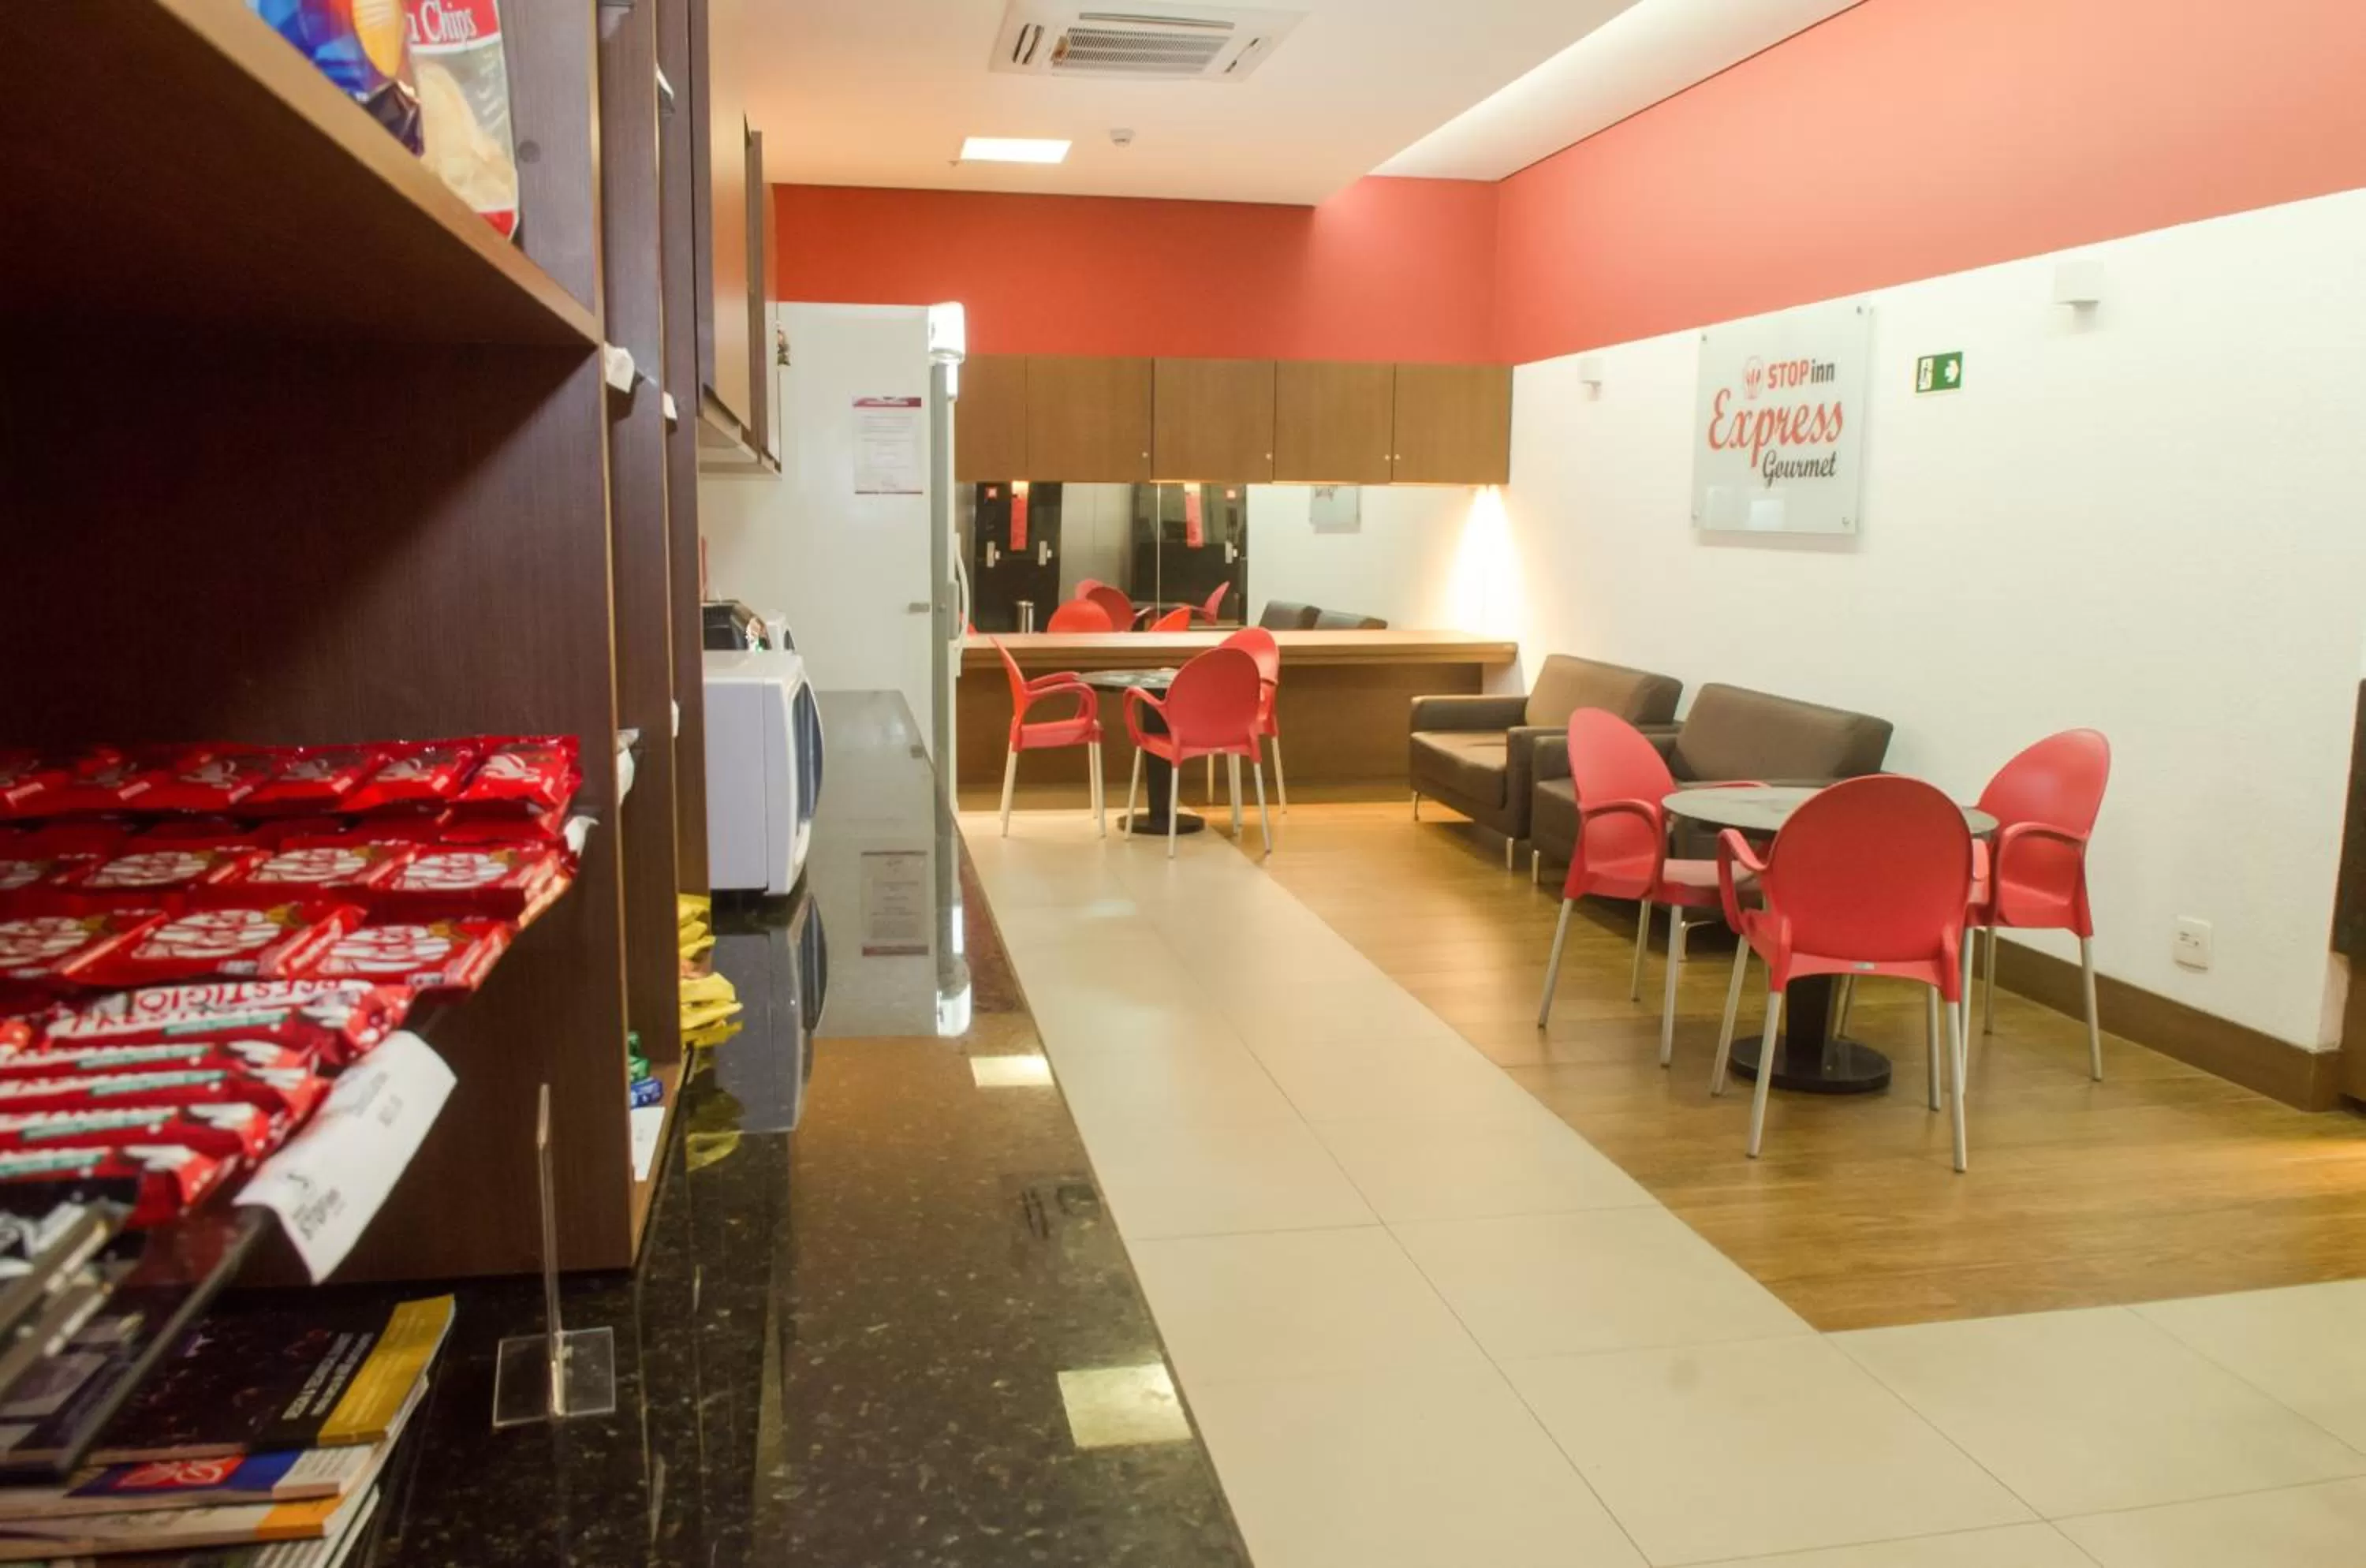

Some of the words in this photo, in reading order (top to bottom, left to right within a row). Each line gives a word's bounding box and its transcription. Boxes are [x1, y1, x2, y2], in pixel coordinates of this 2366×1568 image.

[420, 0, 476, 44] Chips
[1767, 359, 1809, 389] STOP
[1811, 358, 1834, 383] inn
[1708, 387, 1843, 468] Express
[1763, 449, 1837, 488] Gourmet
